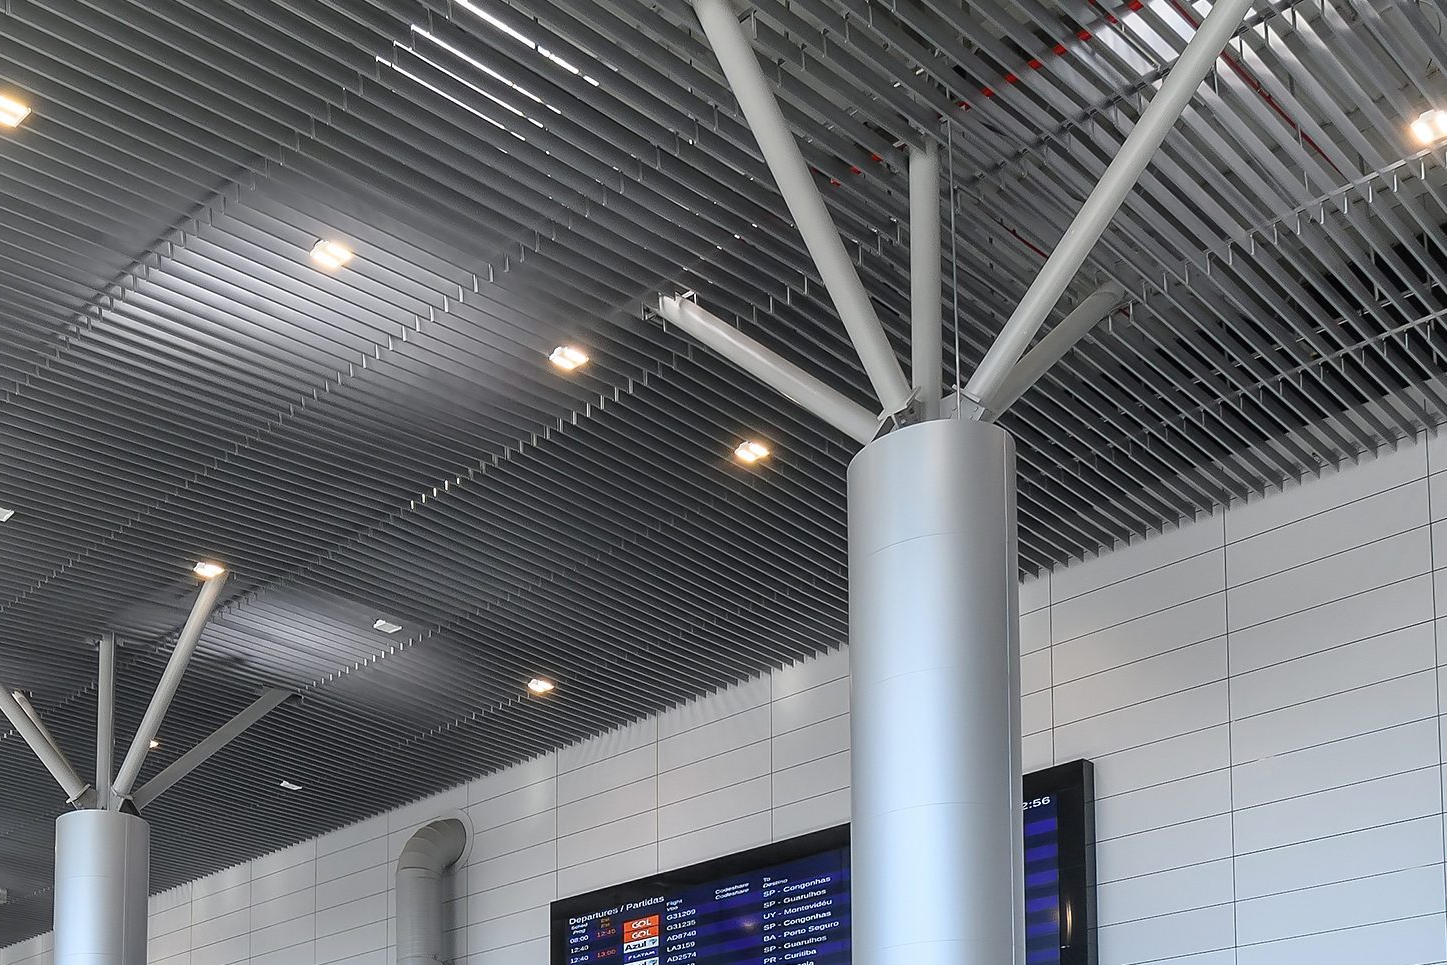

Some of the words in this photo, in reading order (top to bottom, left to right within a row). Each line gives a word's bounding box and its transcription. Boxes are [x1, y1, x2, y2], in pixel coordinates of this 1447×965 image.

[715, 882, 749, 895] Codeshare
[715, 888, 749, 900] Codeshare
[569, 907, 619, 925] Departures
[626, 896, 665, 911] Partidas
[570, 935, 589, 943] 08:00
[632, 919, 651, 929] GOL
[763, 889, 775, 897] SP
[783, 876, 831, 892] Congonhas
[570, 945, 589, 953] 12:40
[632, 929, 651, 939] GOL
[763, 901, 775, 909] SP
[783, 889, 826, 903] Guarulhos
[570, 955, 589, 964] 12:40
[625, 941, 646, 952] Azul
[763, 911, 777, 920] UY
[633, 951, 655, 959] LATAM
[763, 923, 776, 931] SP
[783, 911, 831, 926] Congonhas
[667, 952, 696, 962] AD2574
[763, 934, 776, 942] BA
[784, 928, 806, 937] Porto
[808, 921, 839, 932] Seguro
[763, 945, 776, 953] SP
[783, 935, 827, 949] Guarulhos
[784, 949, 817, 960] Curitiba
